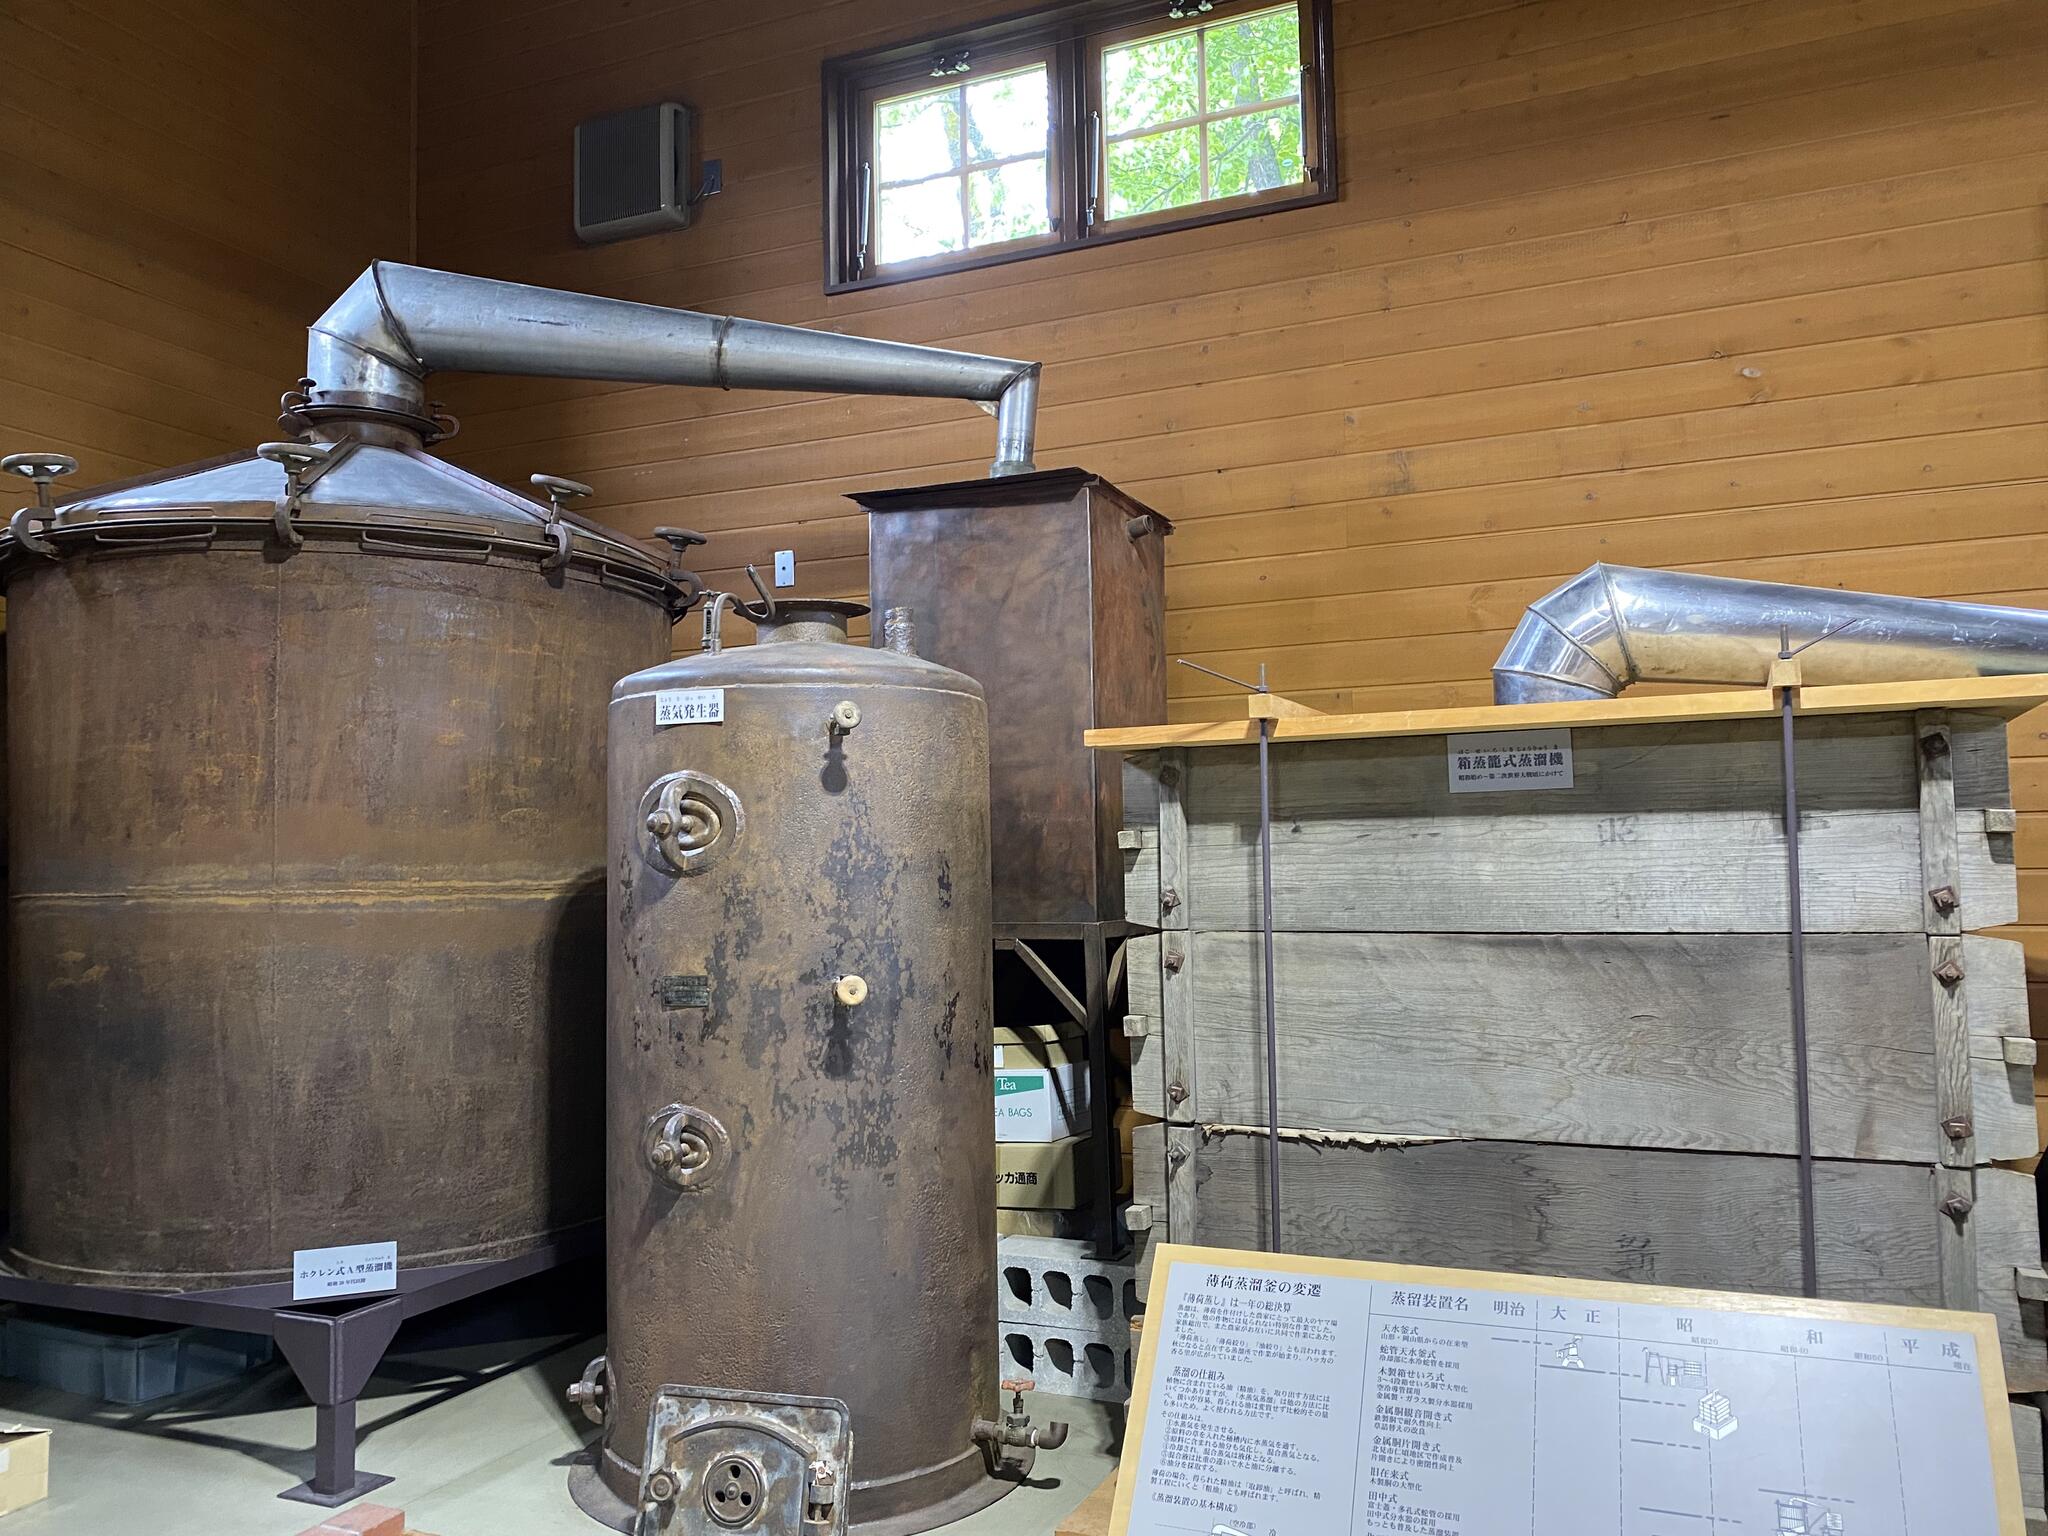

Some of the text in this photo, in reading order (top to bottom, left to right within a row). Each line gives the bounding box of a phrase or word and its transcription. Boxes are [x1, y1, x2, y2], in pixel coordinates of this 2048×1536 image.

[660, 703, 719, 720] 蒸気発生器
[997, 1077, 1016, 1090] Tea
[1008, 1107, 1033, 1117] BAGS
[1206, 1273, 1322, 1297] 薄荷蒸溜釜の変遷
[1391, 1291, 1469, 1311] 蒸留装置名
[1493, 1300, 1526, 1317] 明治
[1382, 1323, 1419, 1336] 天水釜式
[1379, 1344, 1436, 1359] 蛇管天水釜式
[1378, 1366, 1445, 1382] 木製箱せいろ式
[1370, 1467, 1409, 1481] 旧在来式
[1368, 1491, 1398, 1504] 田中式
